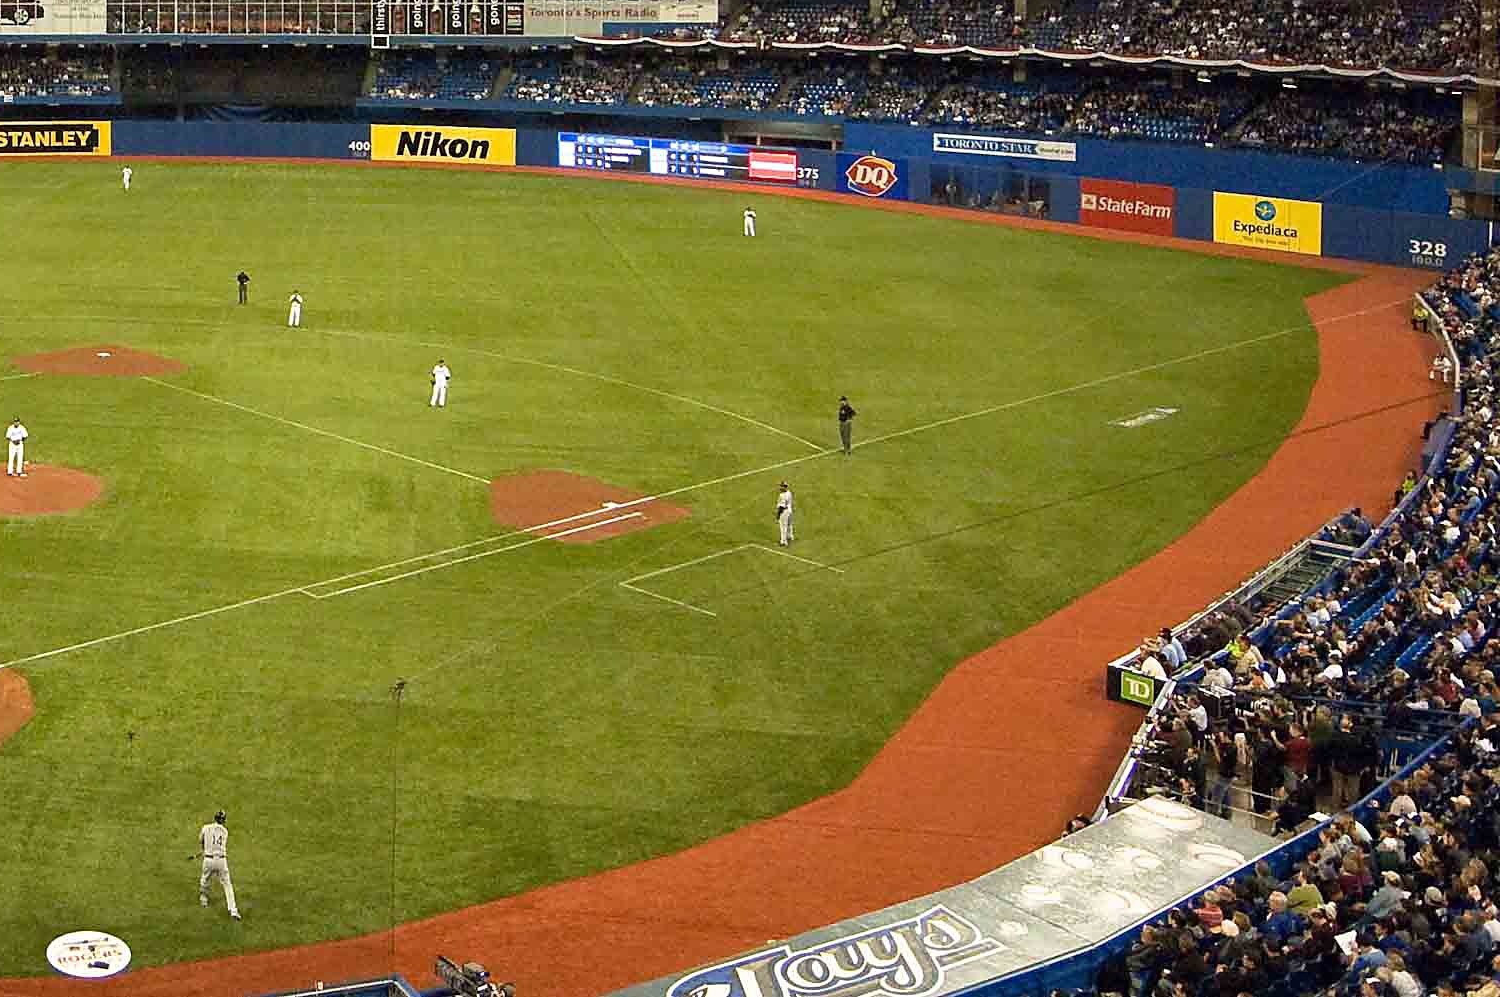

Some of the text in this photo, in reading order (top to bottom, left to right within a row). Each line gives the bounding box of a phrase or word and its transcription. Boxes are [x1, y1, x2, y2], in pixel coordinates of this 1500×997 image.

[530, 7, 657, 19] Toronto's Sports Radio
[348, 140, 371, 151] 400
[396, 131, 490, 159] Nikon
[944, 138, 1032, 153] TORONTO STAR
[797, 167, 819, 179] 375
[854, 164, 888, 187] DQ
[1233, 219, 1298, 237] Expedia.ca
[1409, 239, 1447, 257] 328
[1125, 678, 1150, 699] TD
[212, 835, 223, 846] 14
[664, 903, 1007, 997] Jays
